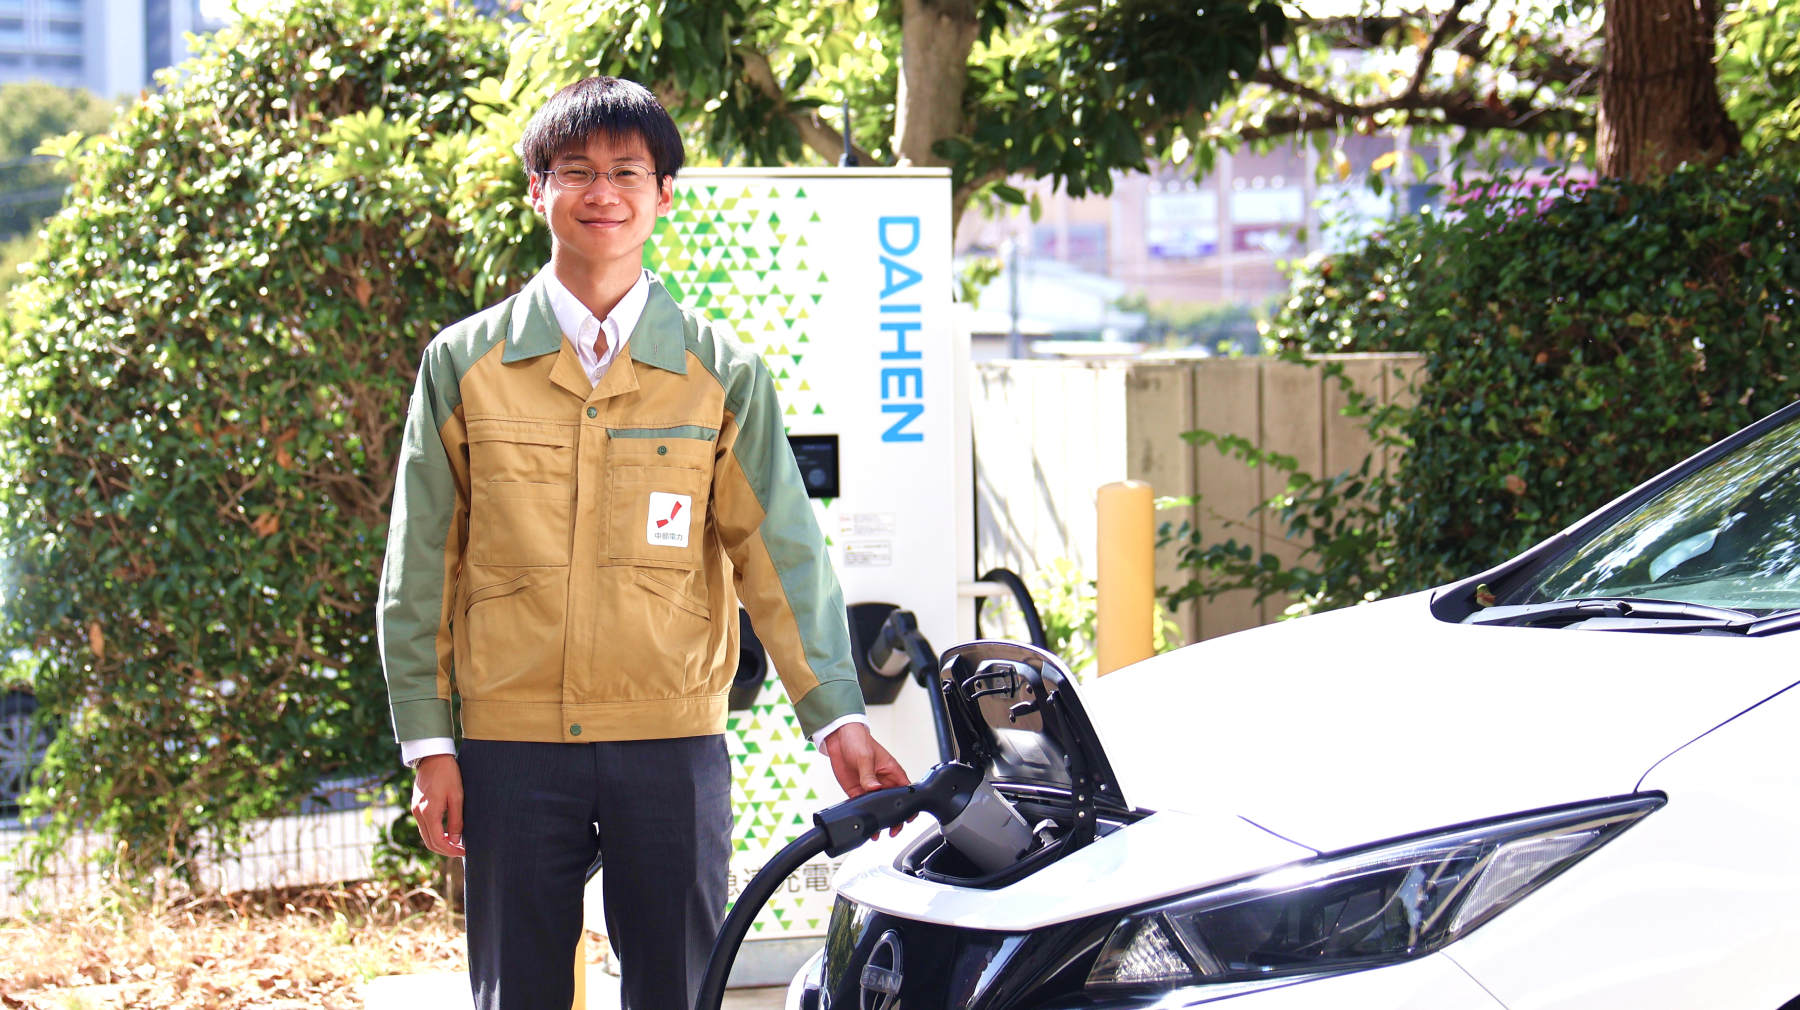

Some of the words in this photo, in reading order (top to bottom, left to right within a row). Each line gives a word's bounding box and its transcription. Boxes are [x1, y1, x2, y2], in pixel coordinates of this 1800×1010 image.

[878, 216, 924, 442] DAIHEN
[654, 532, 683, 541] 中部電力
